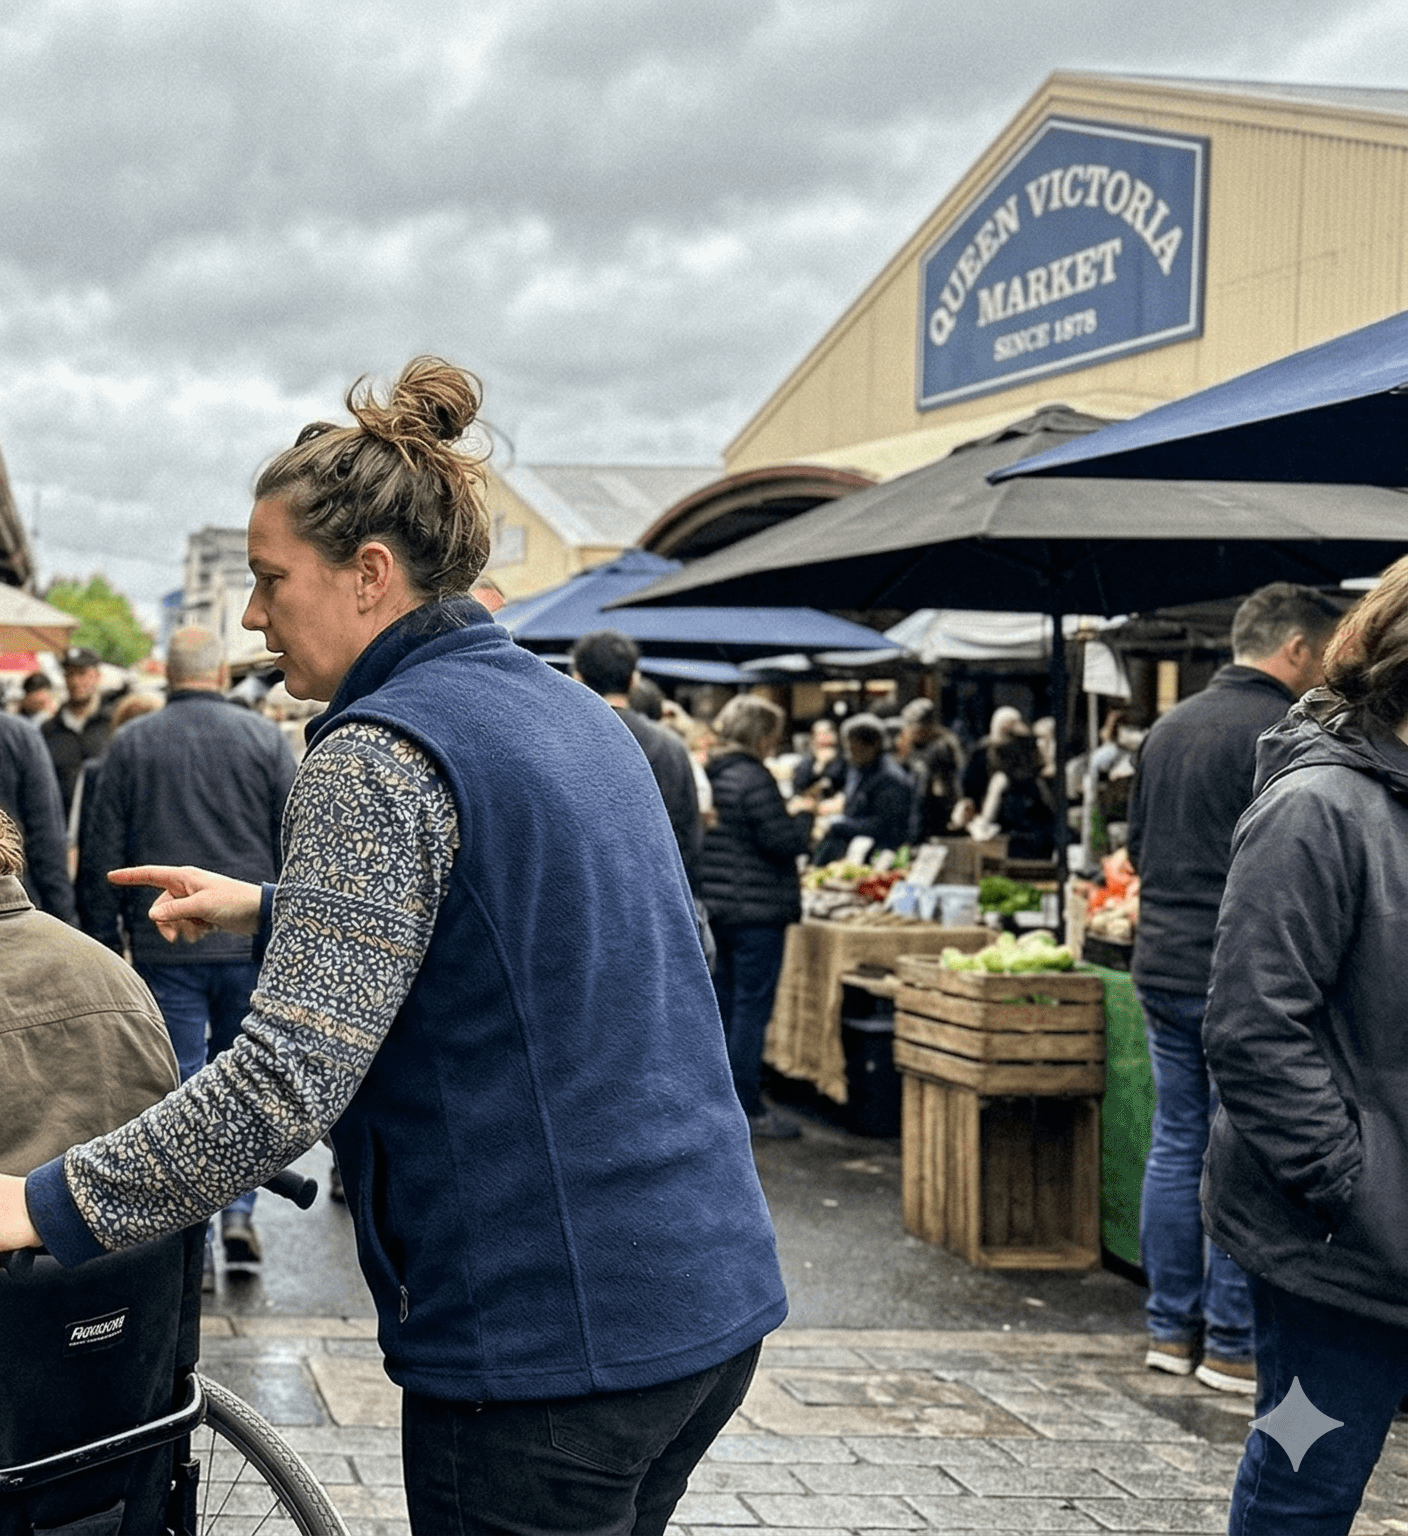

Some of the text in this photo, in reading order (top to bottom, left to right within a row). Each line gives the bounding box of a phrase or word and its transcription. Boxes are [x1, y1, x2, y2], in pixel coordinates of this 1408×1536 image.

[929, 163, 1184, 347] QUEEN VICTORIA
[976, 237, 1123, 329] MARKET
[993, 322, 1051, 362] SINCE
